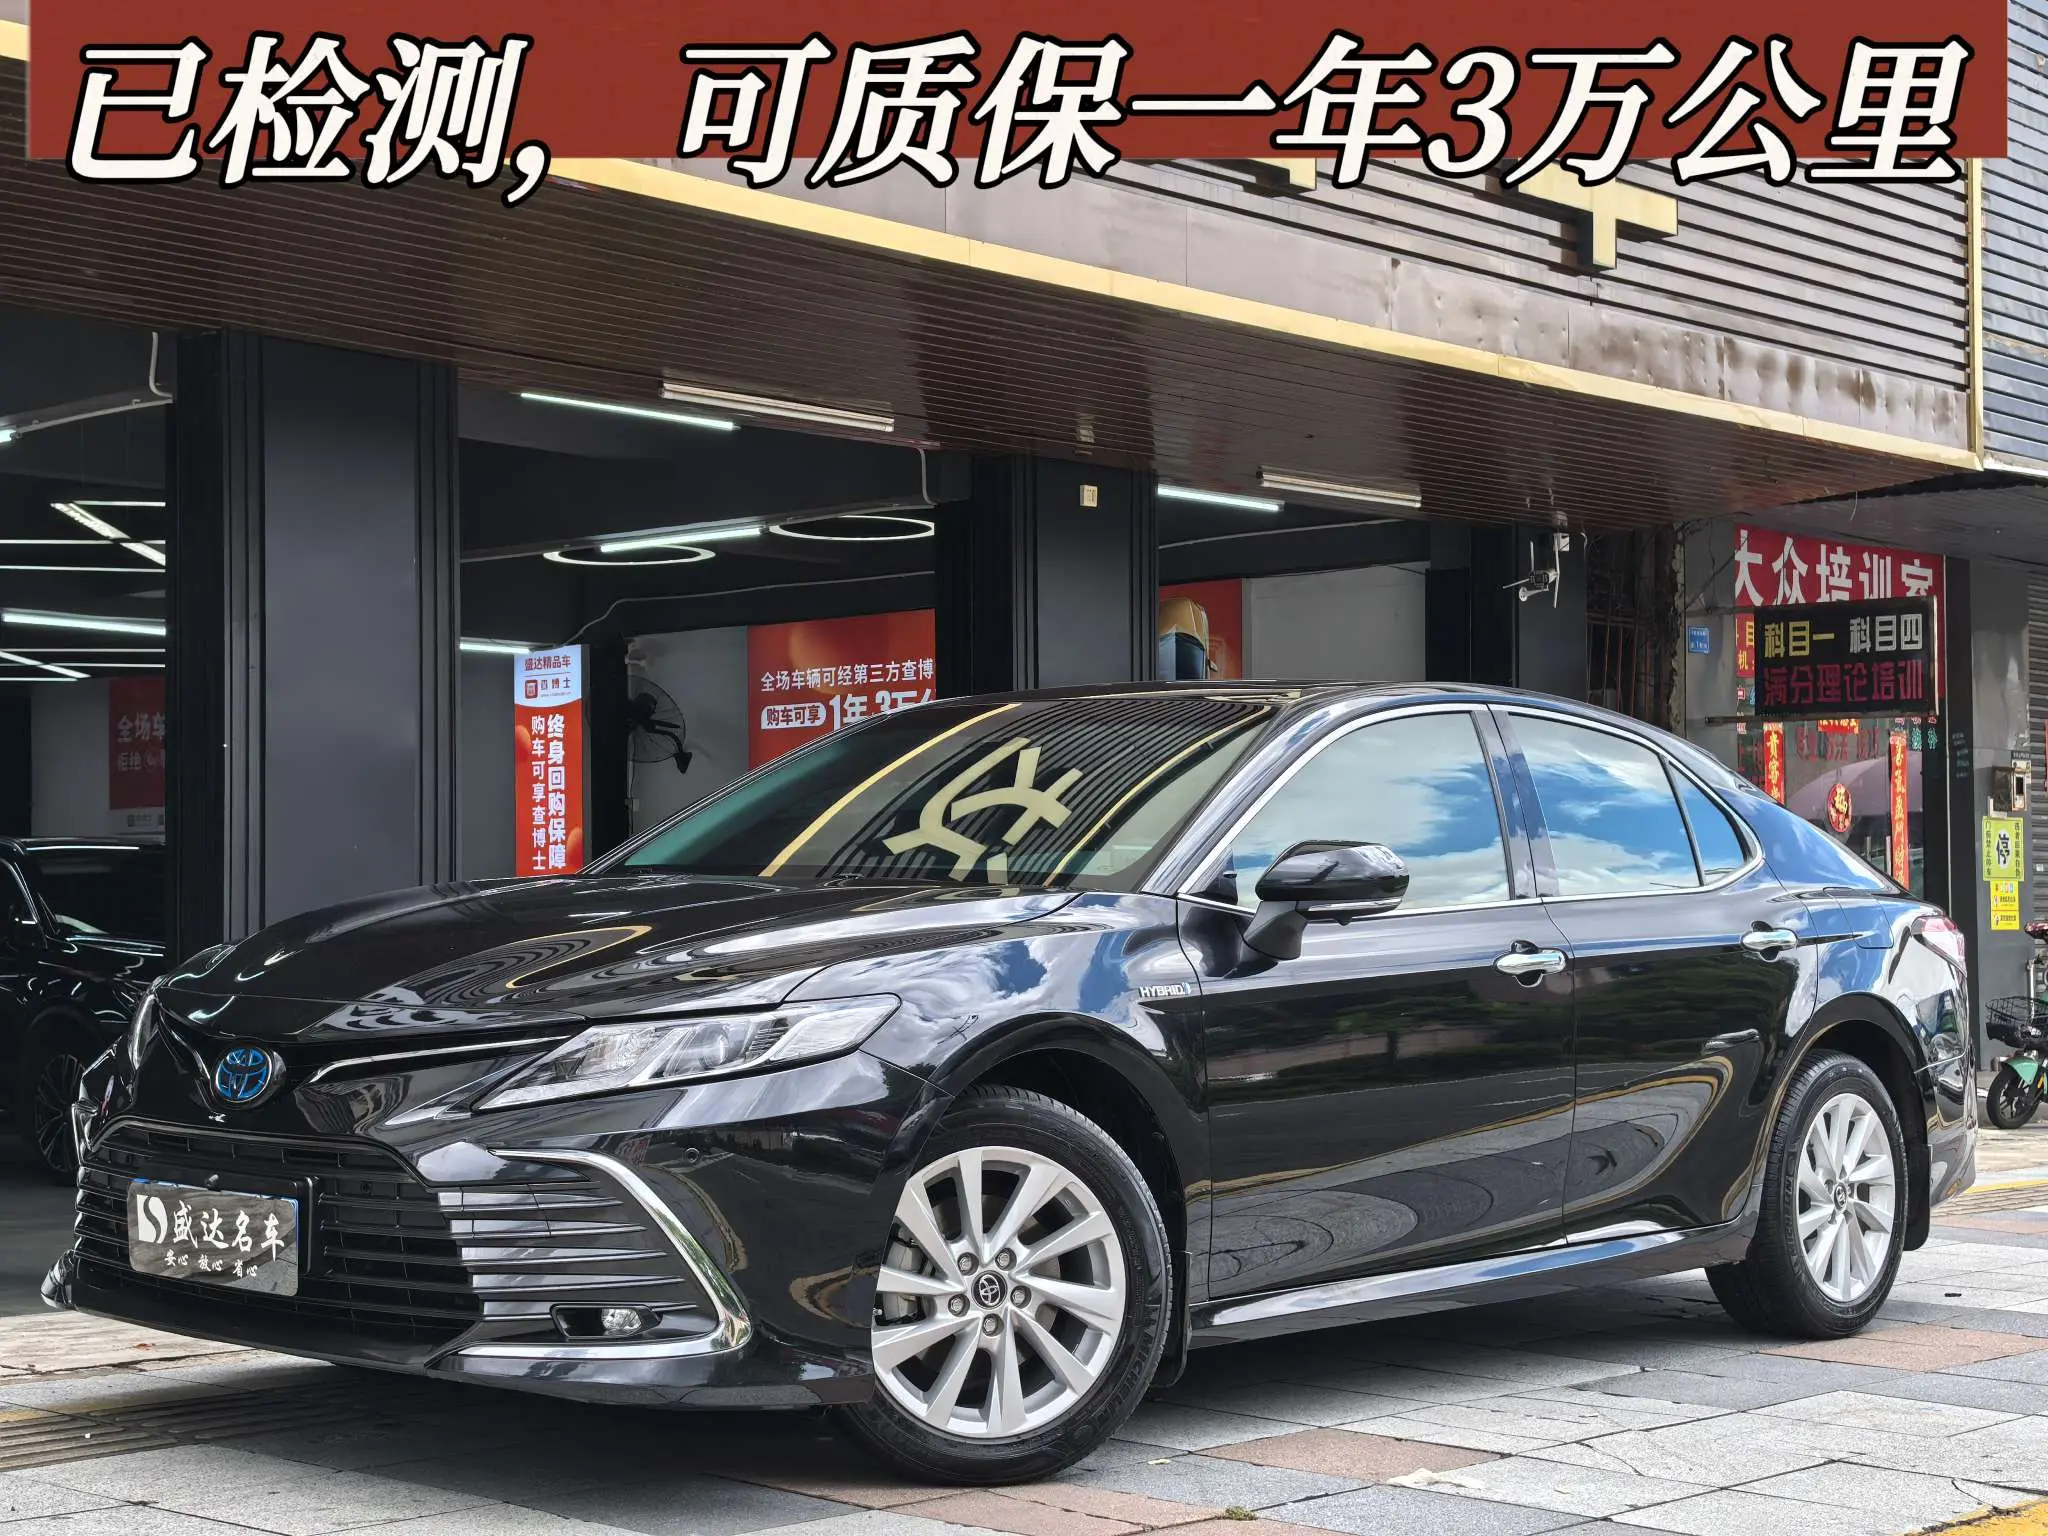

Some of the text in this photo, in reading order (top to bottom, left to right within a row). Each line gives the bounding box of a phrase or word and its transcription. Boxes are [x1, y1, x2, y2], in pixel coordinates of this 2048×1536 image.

[1764, 613, 1923, 658] 科目一 科目四
[761, 658, 934, 692] 全场车辆可经第三方查博
[1763, 659, 1924, 706] 满分理论培训
[766, 705, 822, 727] 购车可享
[531, 715, 546, 871] 购车可享查博士
[547, 713, 567, 870] 终身回购保障
[1139, 984, 1184, 997] HYBRID
[173, 1200, 285, 1263] 盛达名车
[164, 1249, 189, 1267] 安心
